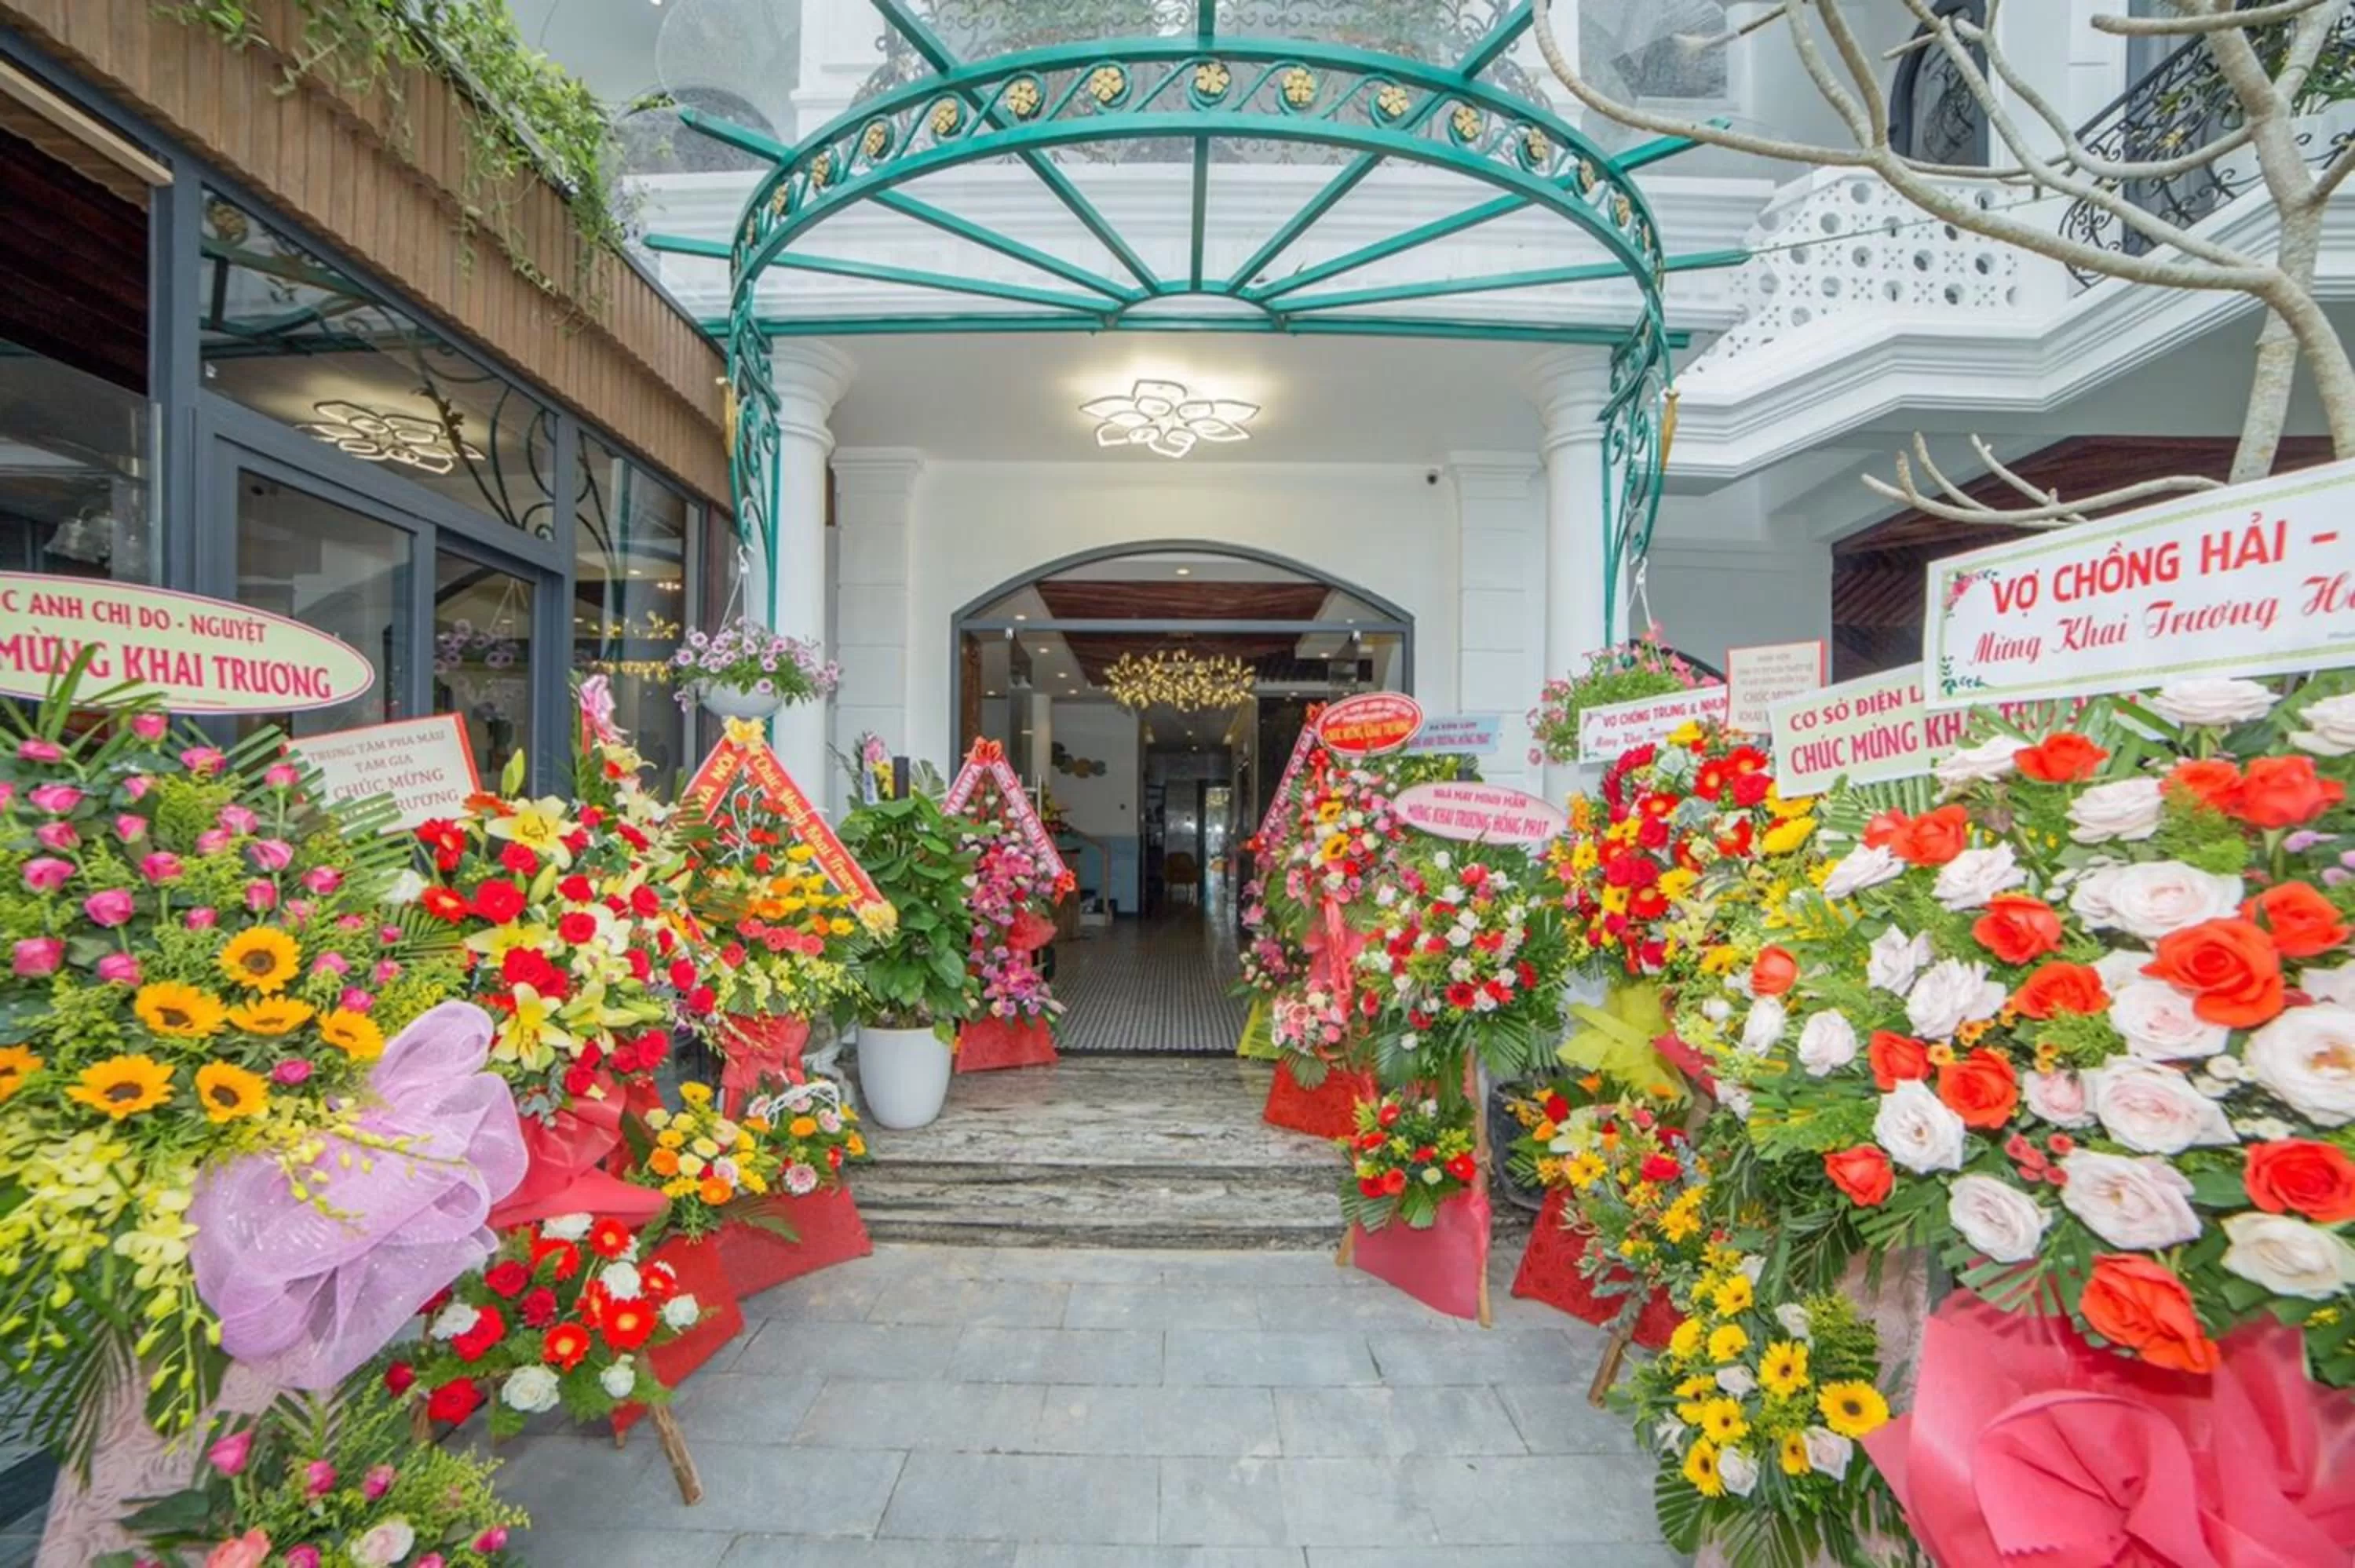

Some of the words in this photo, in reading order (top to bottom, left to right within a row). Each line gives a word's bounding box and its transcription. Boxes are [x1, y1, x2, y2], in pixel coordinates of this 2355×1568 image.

[1992, 568, 2039, 618] VỢ
[2053, 541, 2180, 603] CHỒNG
[2200, 512, 2287, 574] HẢI
[28, 593, 85, 620] ANH
[91, 600, 132, 630] CHỊ
[2051, 614, 2129, 653] Khai
[2145, 597, 2280, 639] Trương
[122, 644, 204, 688] KHAI
[212, 654, 331, 699] TRƯƠNG
[1790, 709, 1818, 732] CƠ
[1823, 698, 1850, 725] SỞ
[1856, 689, 1903, 717] ĐIỆN
[308, 745, 356, 763] TRUNG
[1791, 734, 1846, 775] CHÚC
[1850, 722, 1918, 764] MỪNG
[333, 776, 385, 801] CHÚC
[388, 767, 446, 790] MỪNG
[395, 788, 460, 812] RƯƠNG
